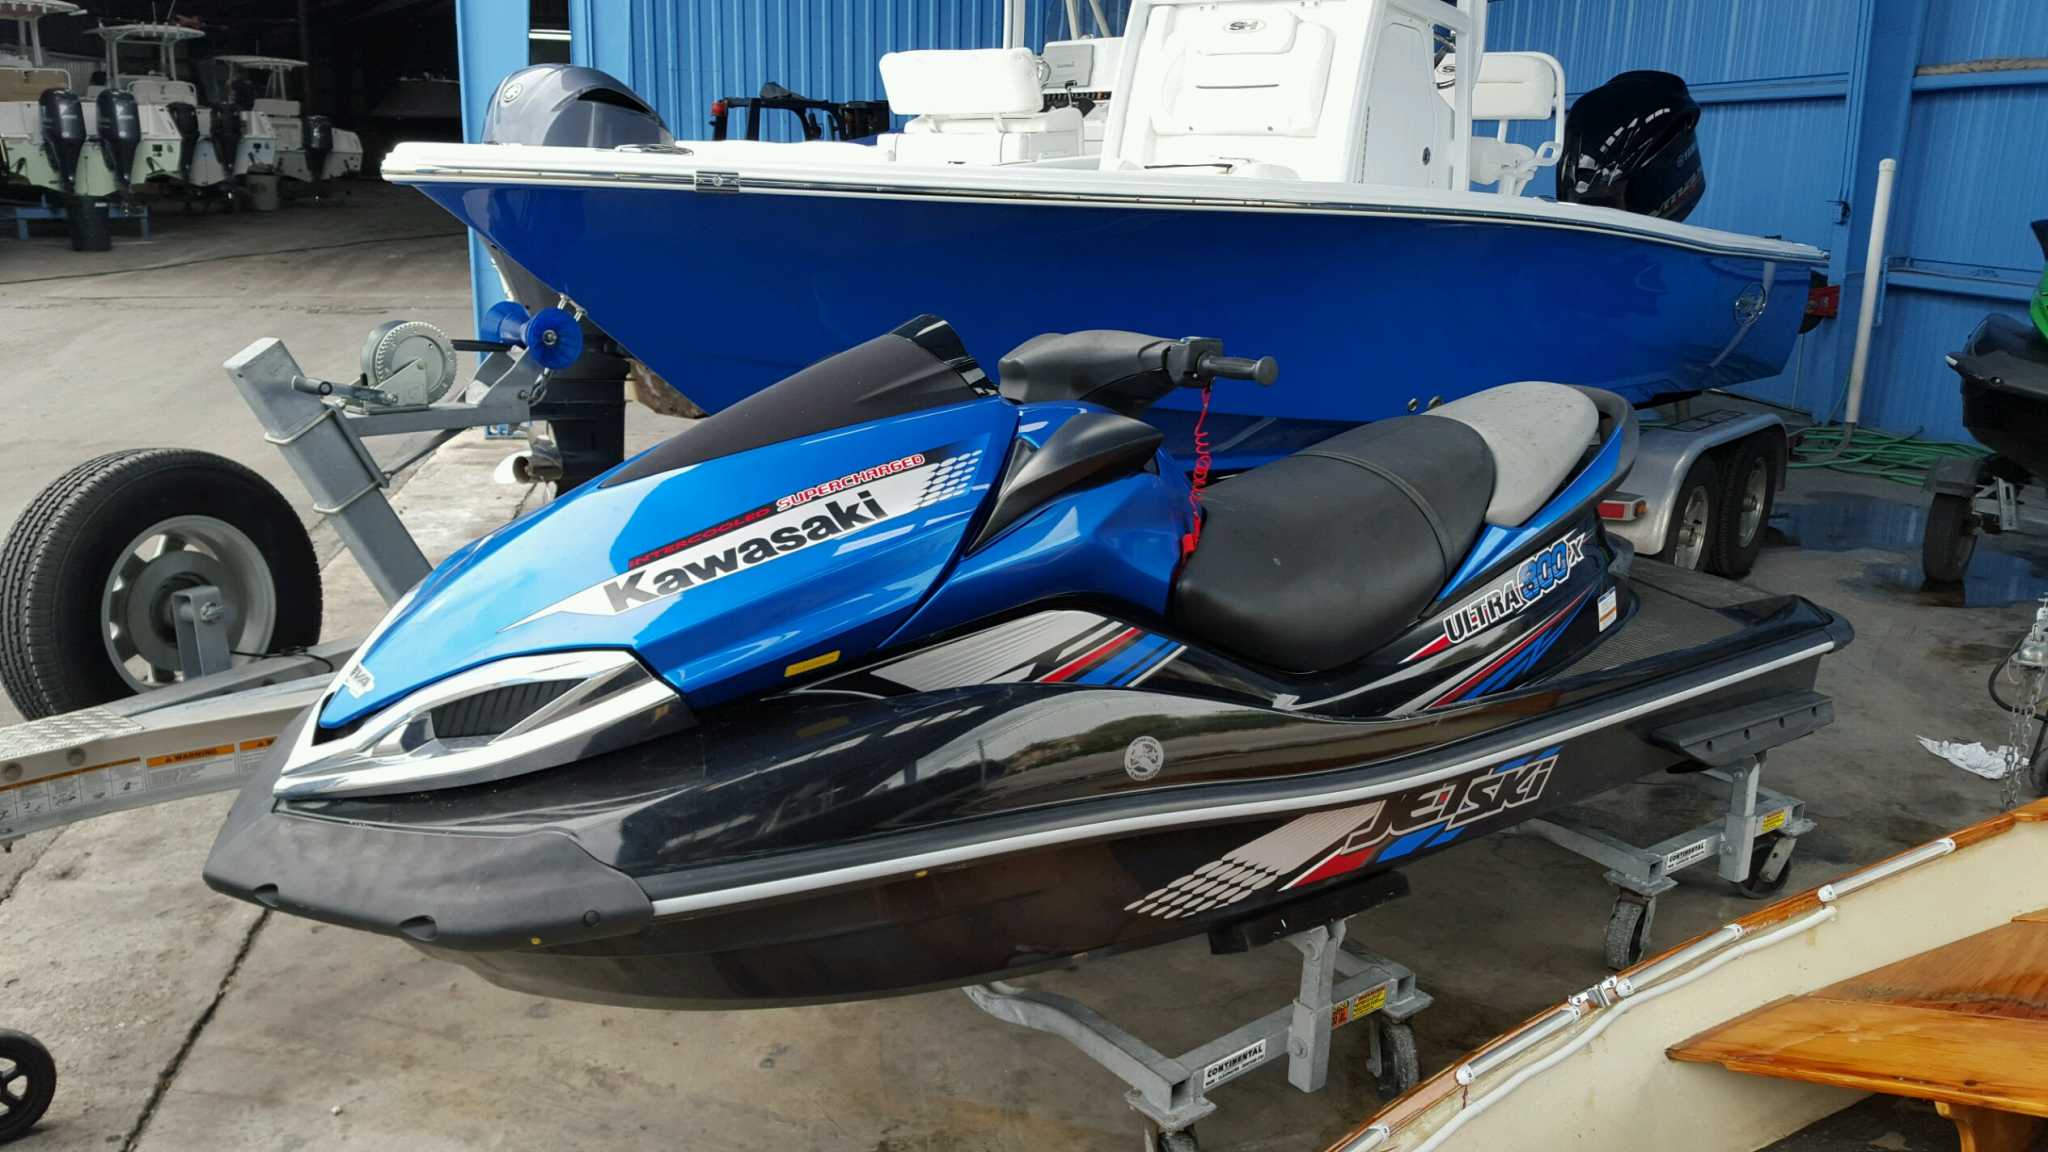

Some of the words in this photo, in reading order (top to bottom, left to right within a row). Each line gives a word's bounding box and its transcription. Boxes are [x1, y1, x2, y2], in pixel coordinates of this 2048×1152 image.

[603, 490, 888, 614] Kawasaki
[628, 507, 771, 569] INTERCOOLED
[776, 453, 925, 512] SUPERCHARGED
[1443, 580, 1523, 644] ULTRA
[1207, 1045, 1263, 1078] CONTINENTAL
